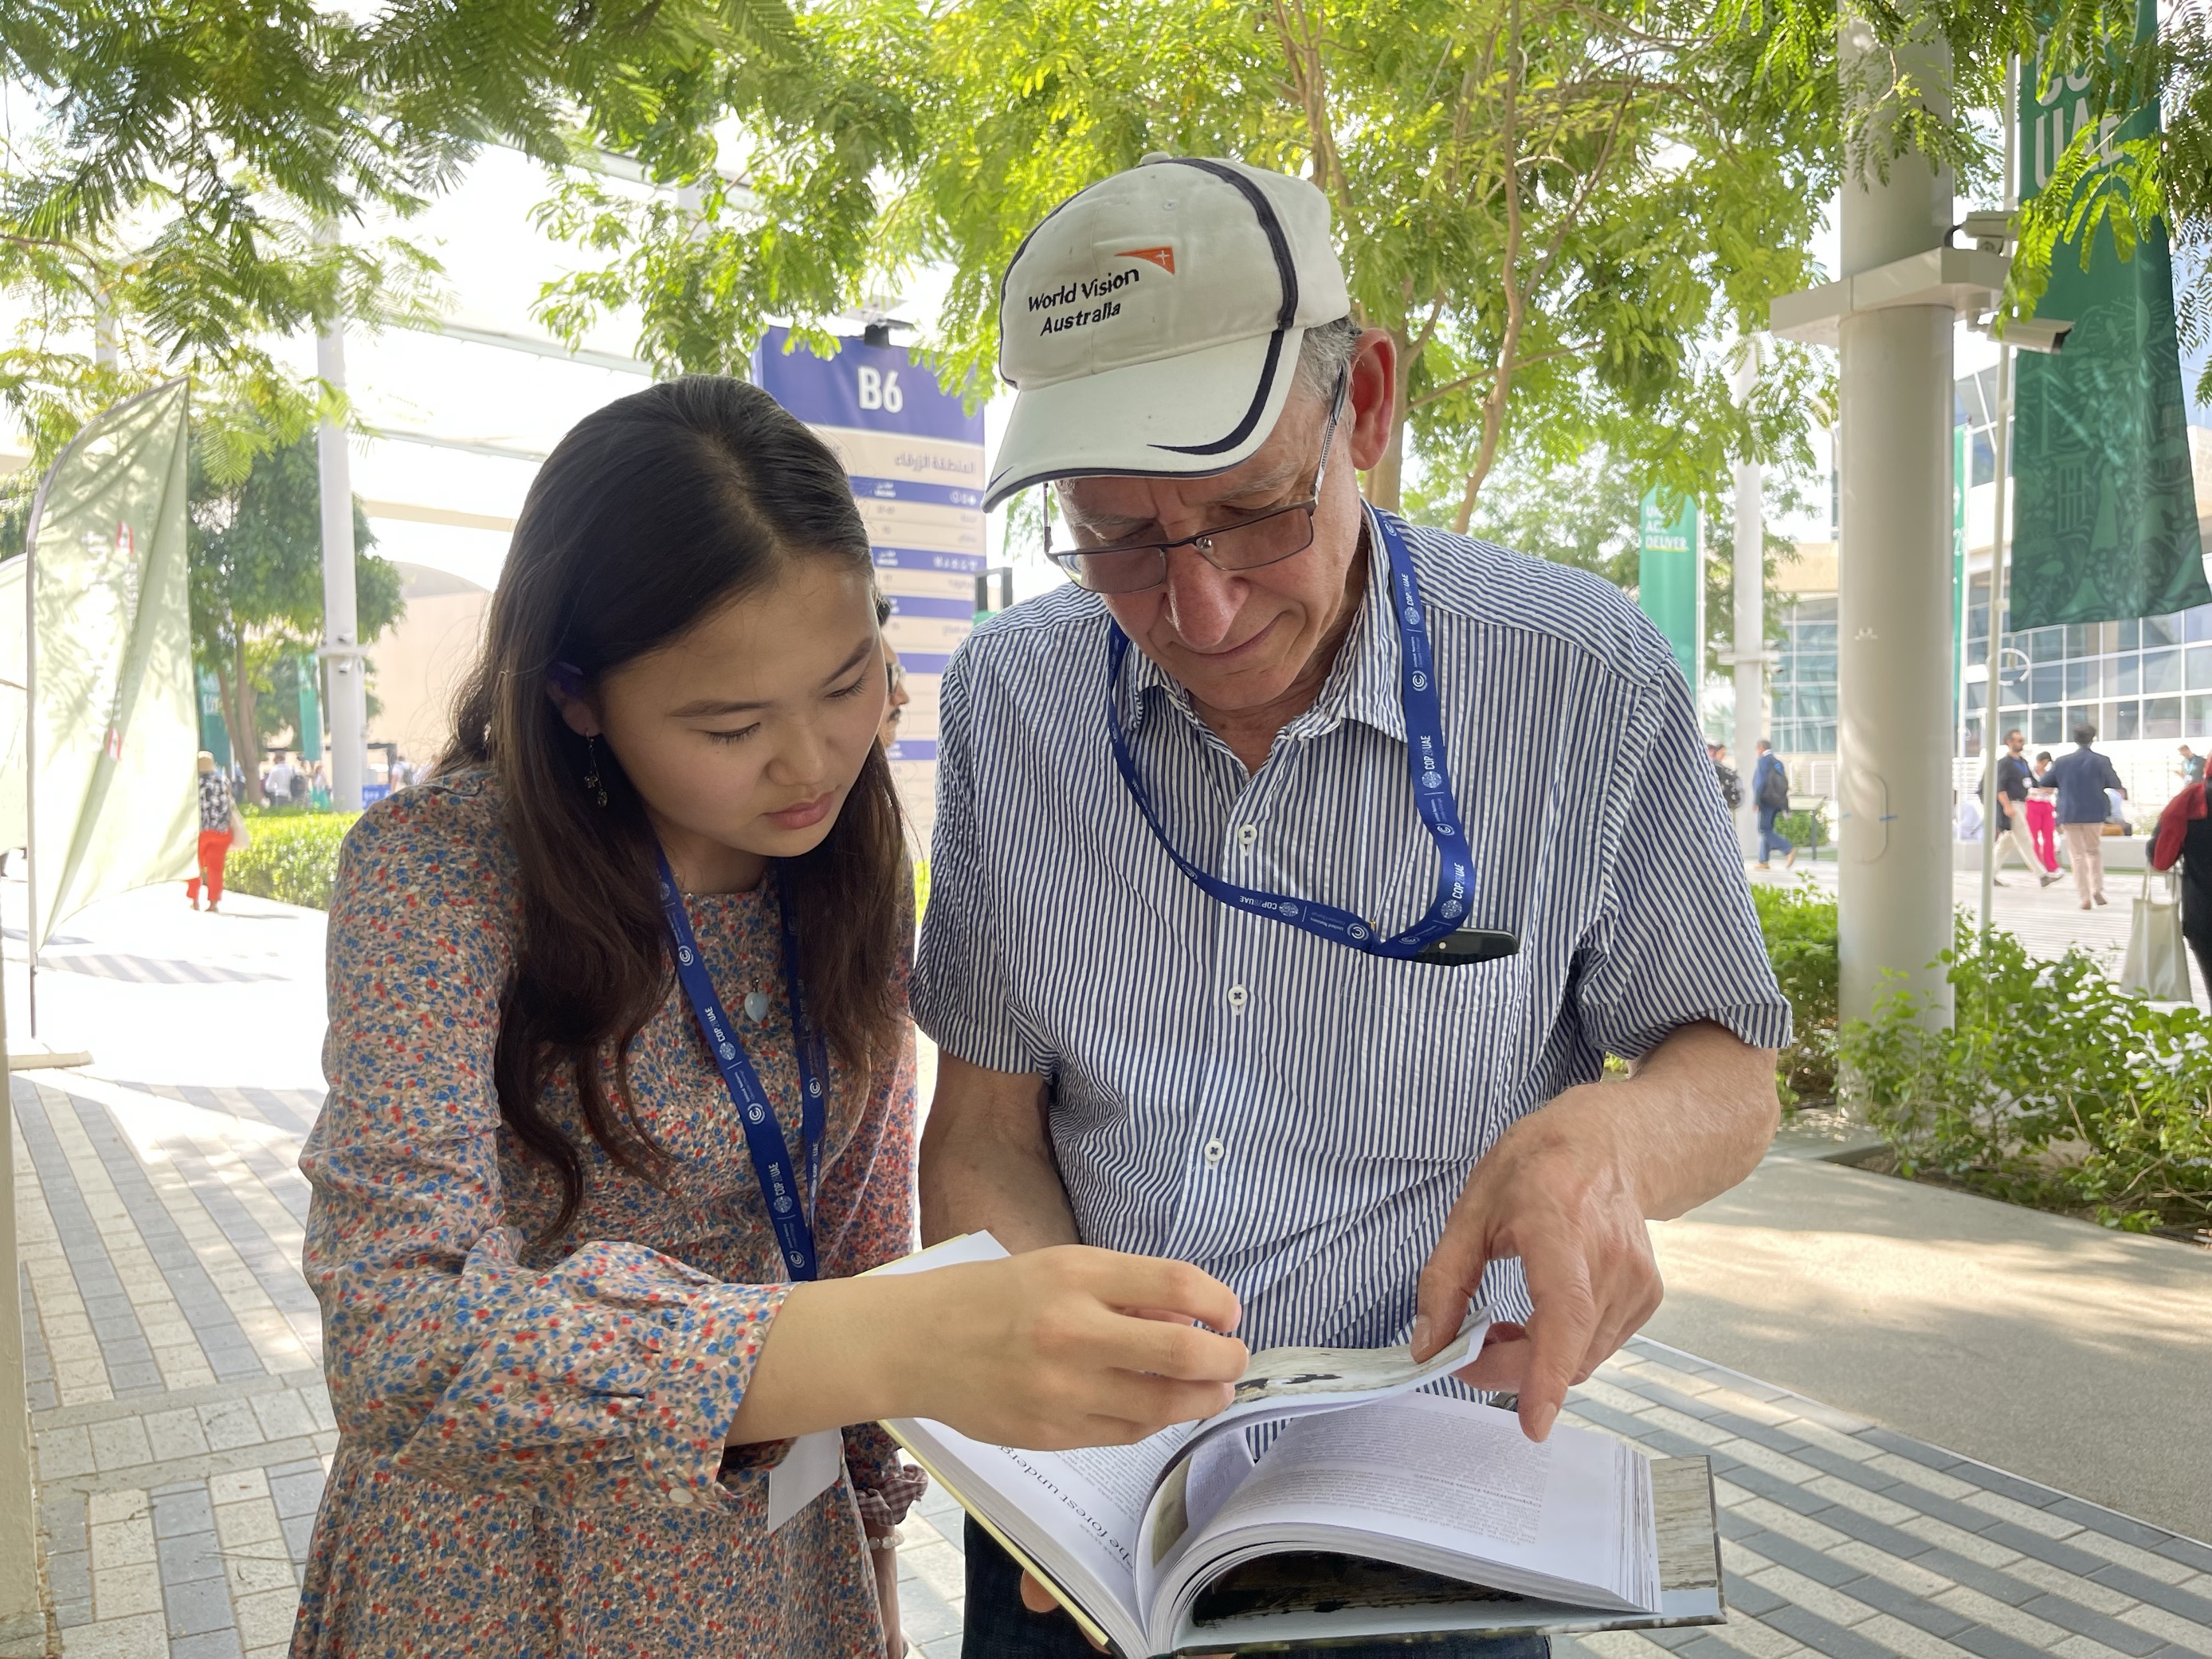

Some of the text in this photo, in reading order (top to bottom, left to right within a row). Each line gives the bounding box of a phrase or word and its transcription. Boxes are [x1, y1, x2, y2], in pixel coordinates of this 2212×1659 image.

[2035, 97, 2124, 190] UAE
[1029, 269, 1139, 312] World Vision
[1040, 301, 1121, 336] Australia
[857, 365, 904, 414] B6
[931, 457, 975, 473] المنطقة
[1420, 735, 1435, 770] COP28UAE
[1451, 862, 1465, 900] COP28UAE
[1059, 1494, 1108, 1538] forest
